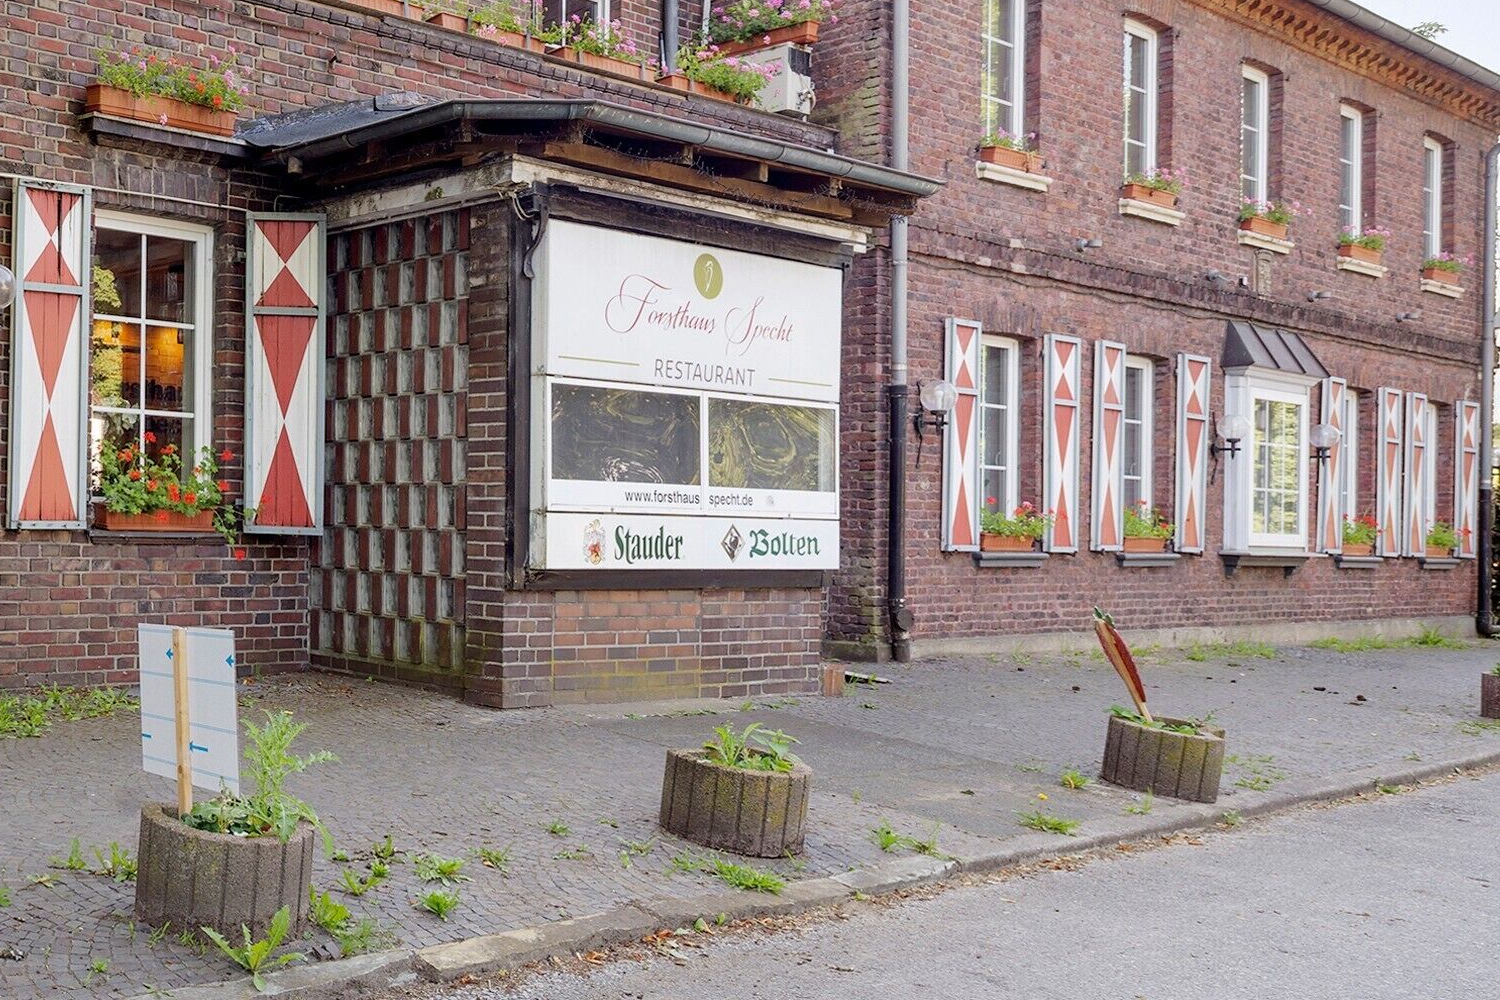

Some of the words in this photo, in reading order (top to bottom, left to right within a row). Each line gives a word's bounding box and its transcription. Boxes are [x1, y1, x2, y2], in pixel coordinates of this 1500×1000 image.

[604, 274, 717, 335] Forsthaus
[724, 295, 794, 357] Specht
[654, 358, 756, 387] RESTAURANT
[613, 524, 684, 565] Stauder
[749, 528, 821, 559] Bolten
